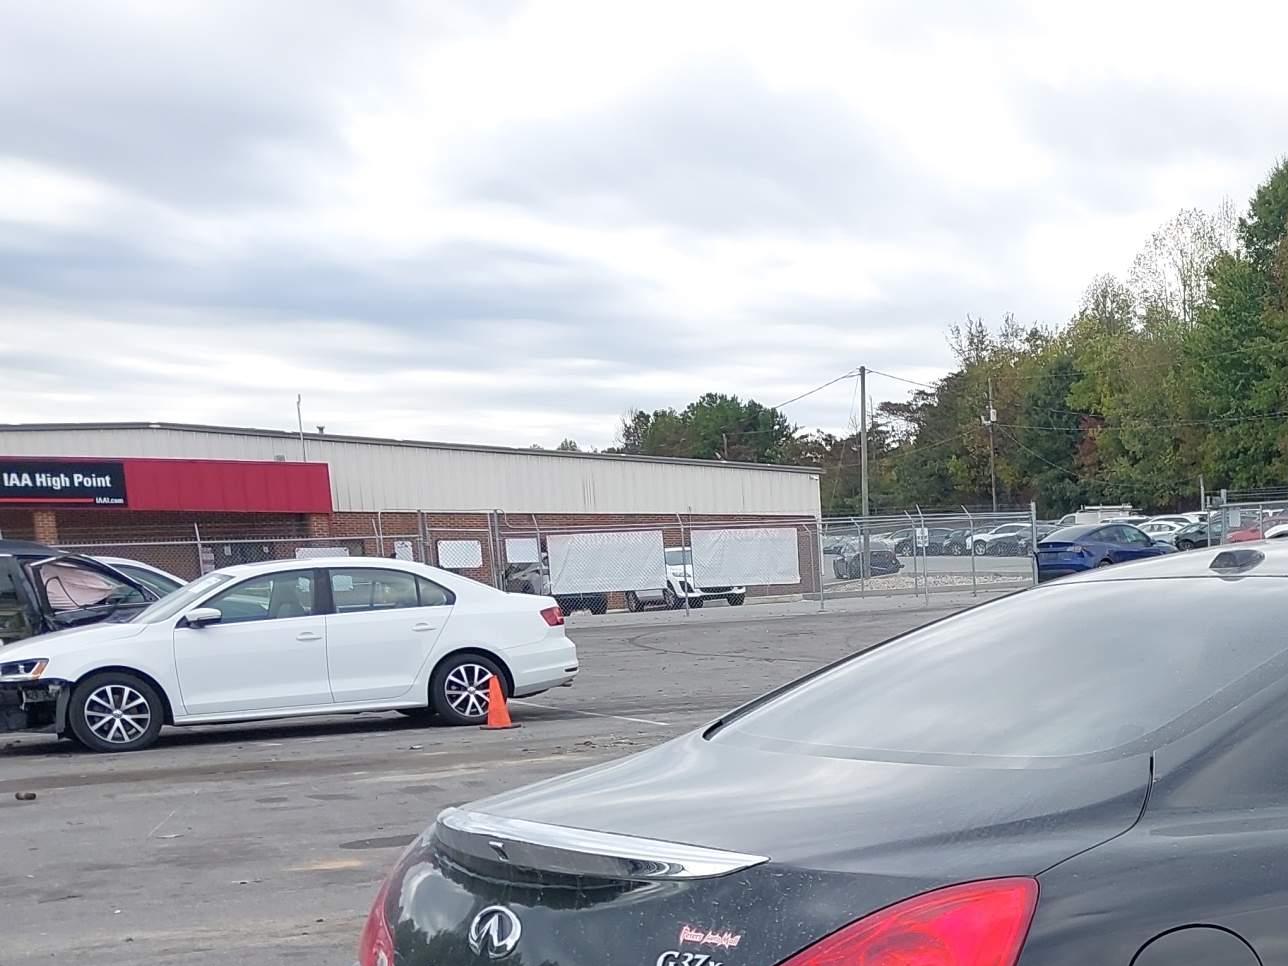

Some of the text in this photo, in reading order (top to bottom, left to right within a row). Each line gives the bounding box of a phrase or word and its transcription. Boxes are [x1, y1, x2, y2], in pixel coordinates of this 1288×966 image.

[2, 472, 111, 490] IAA High Point
